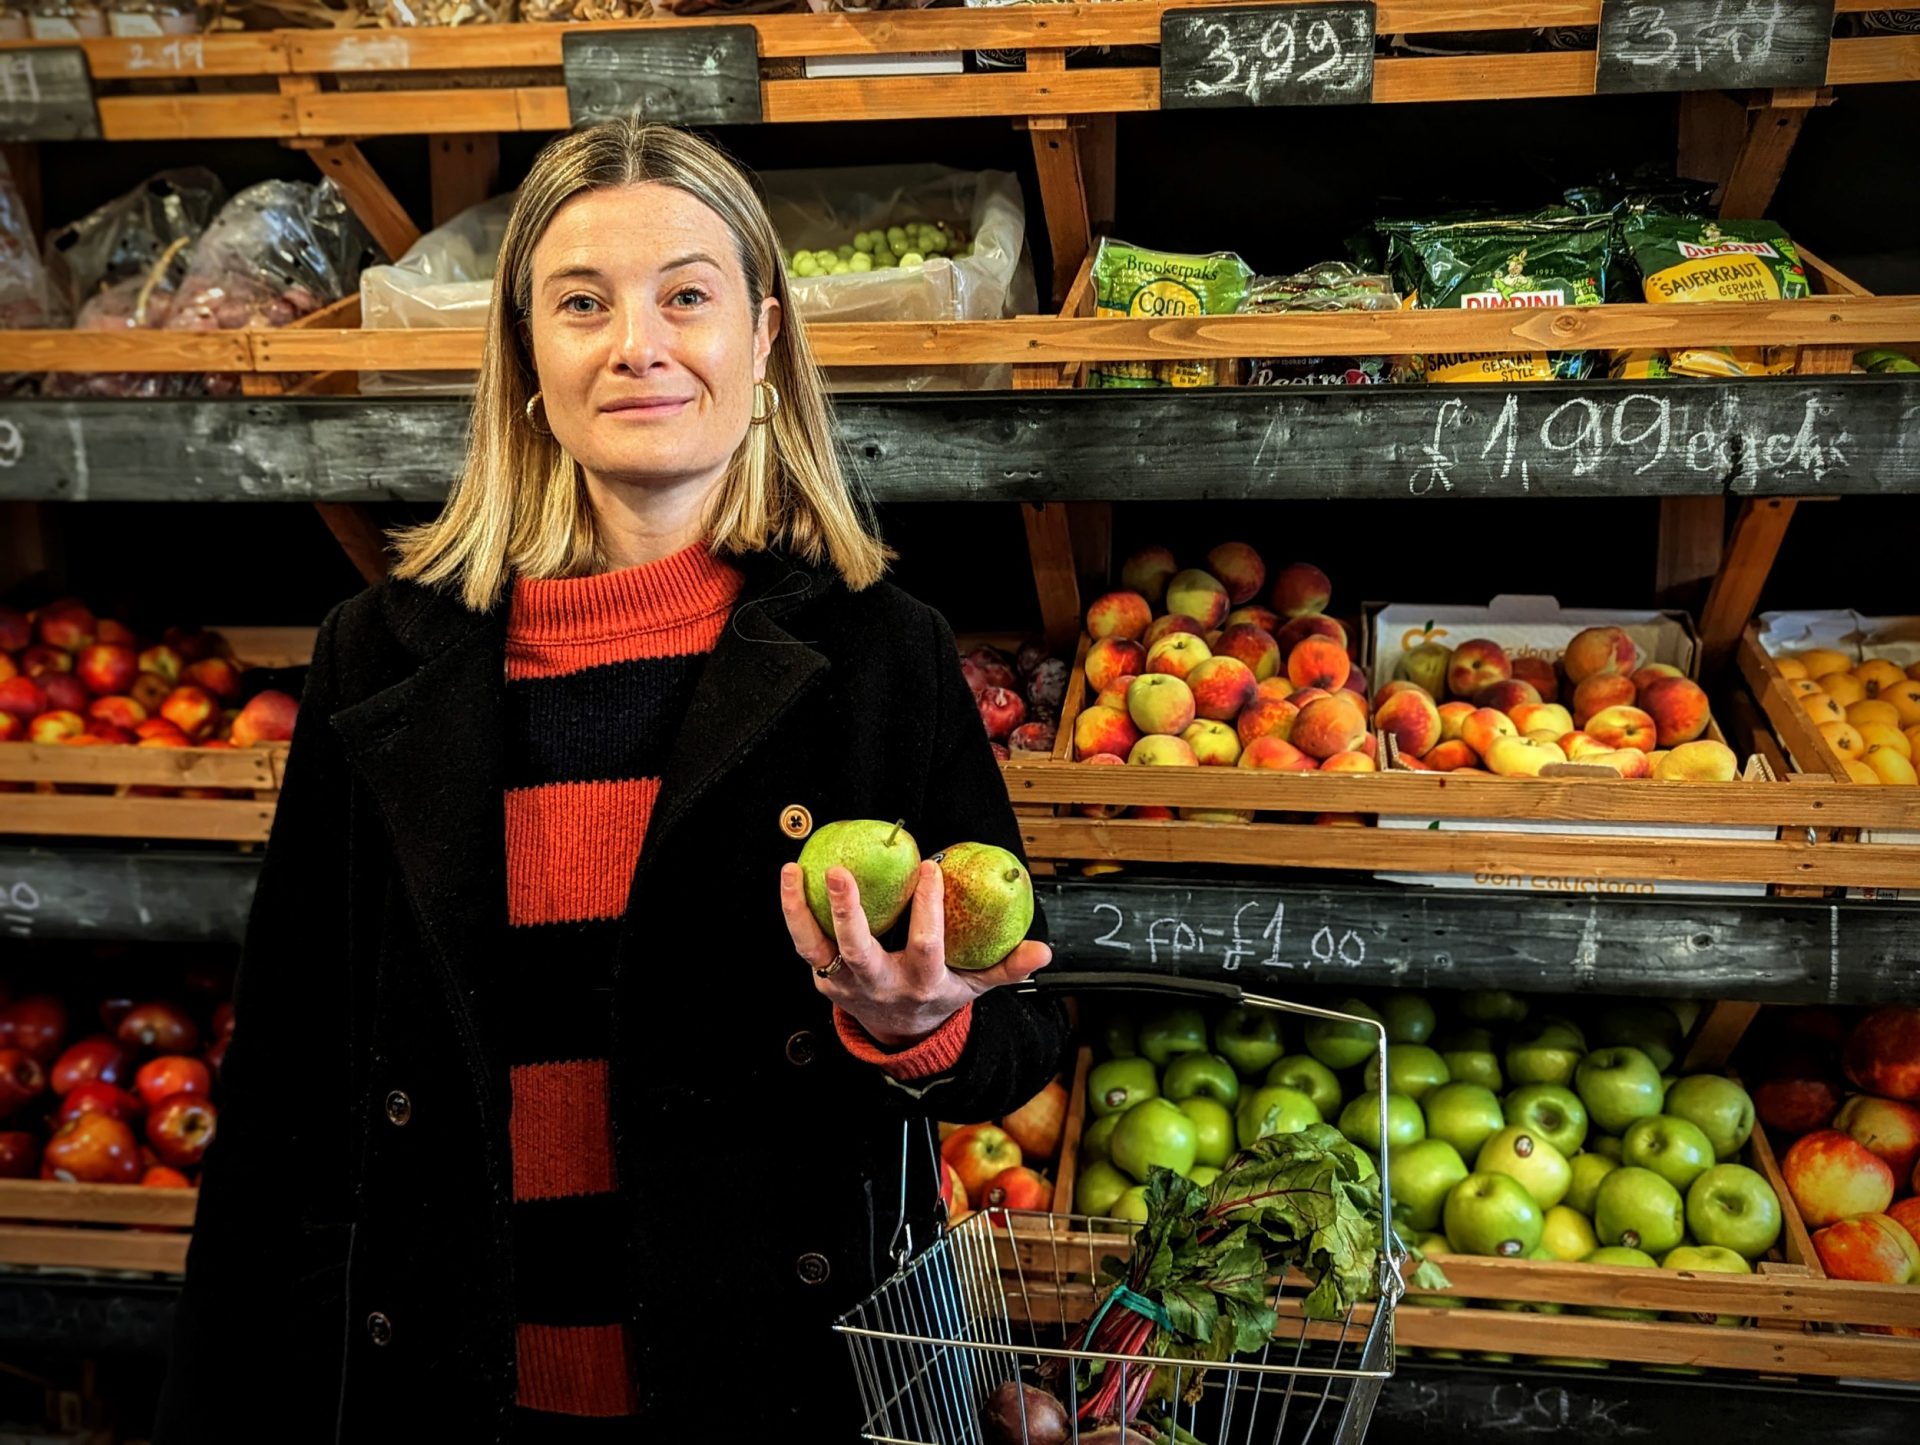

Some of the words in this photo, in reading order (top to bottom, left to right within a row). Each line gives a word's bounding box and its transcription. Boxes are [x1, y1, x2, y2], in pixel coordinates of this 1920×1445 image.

[1684, 243, 1773, 258] DIMDINI
[1127, 255, 1218, 282] Brookerpaks
[1470, 272, 1491, 280] ANNO
[1660, 263, 1762, 297] SAUERKRAUT
[1719, 279, 1764, 297] GERMAN
[1139, 292, 1186, 315] Corn
[1466, 295, 1560, 308] DIMDINI
[1738, 291, 1769, 301] STYLE
[1482, 353, 1533, 374] GERMAN
[1501, 368, 1535, 382] STYLE
[1094, 904, 1131, 950] 2
